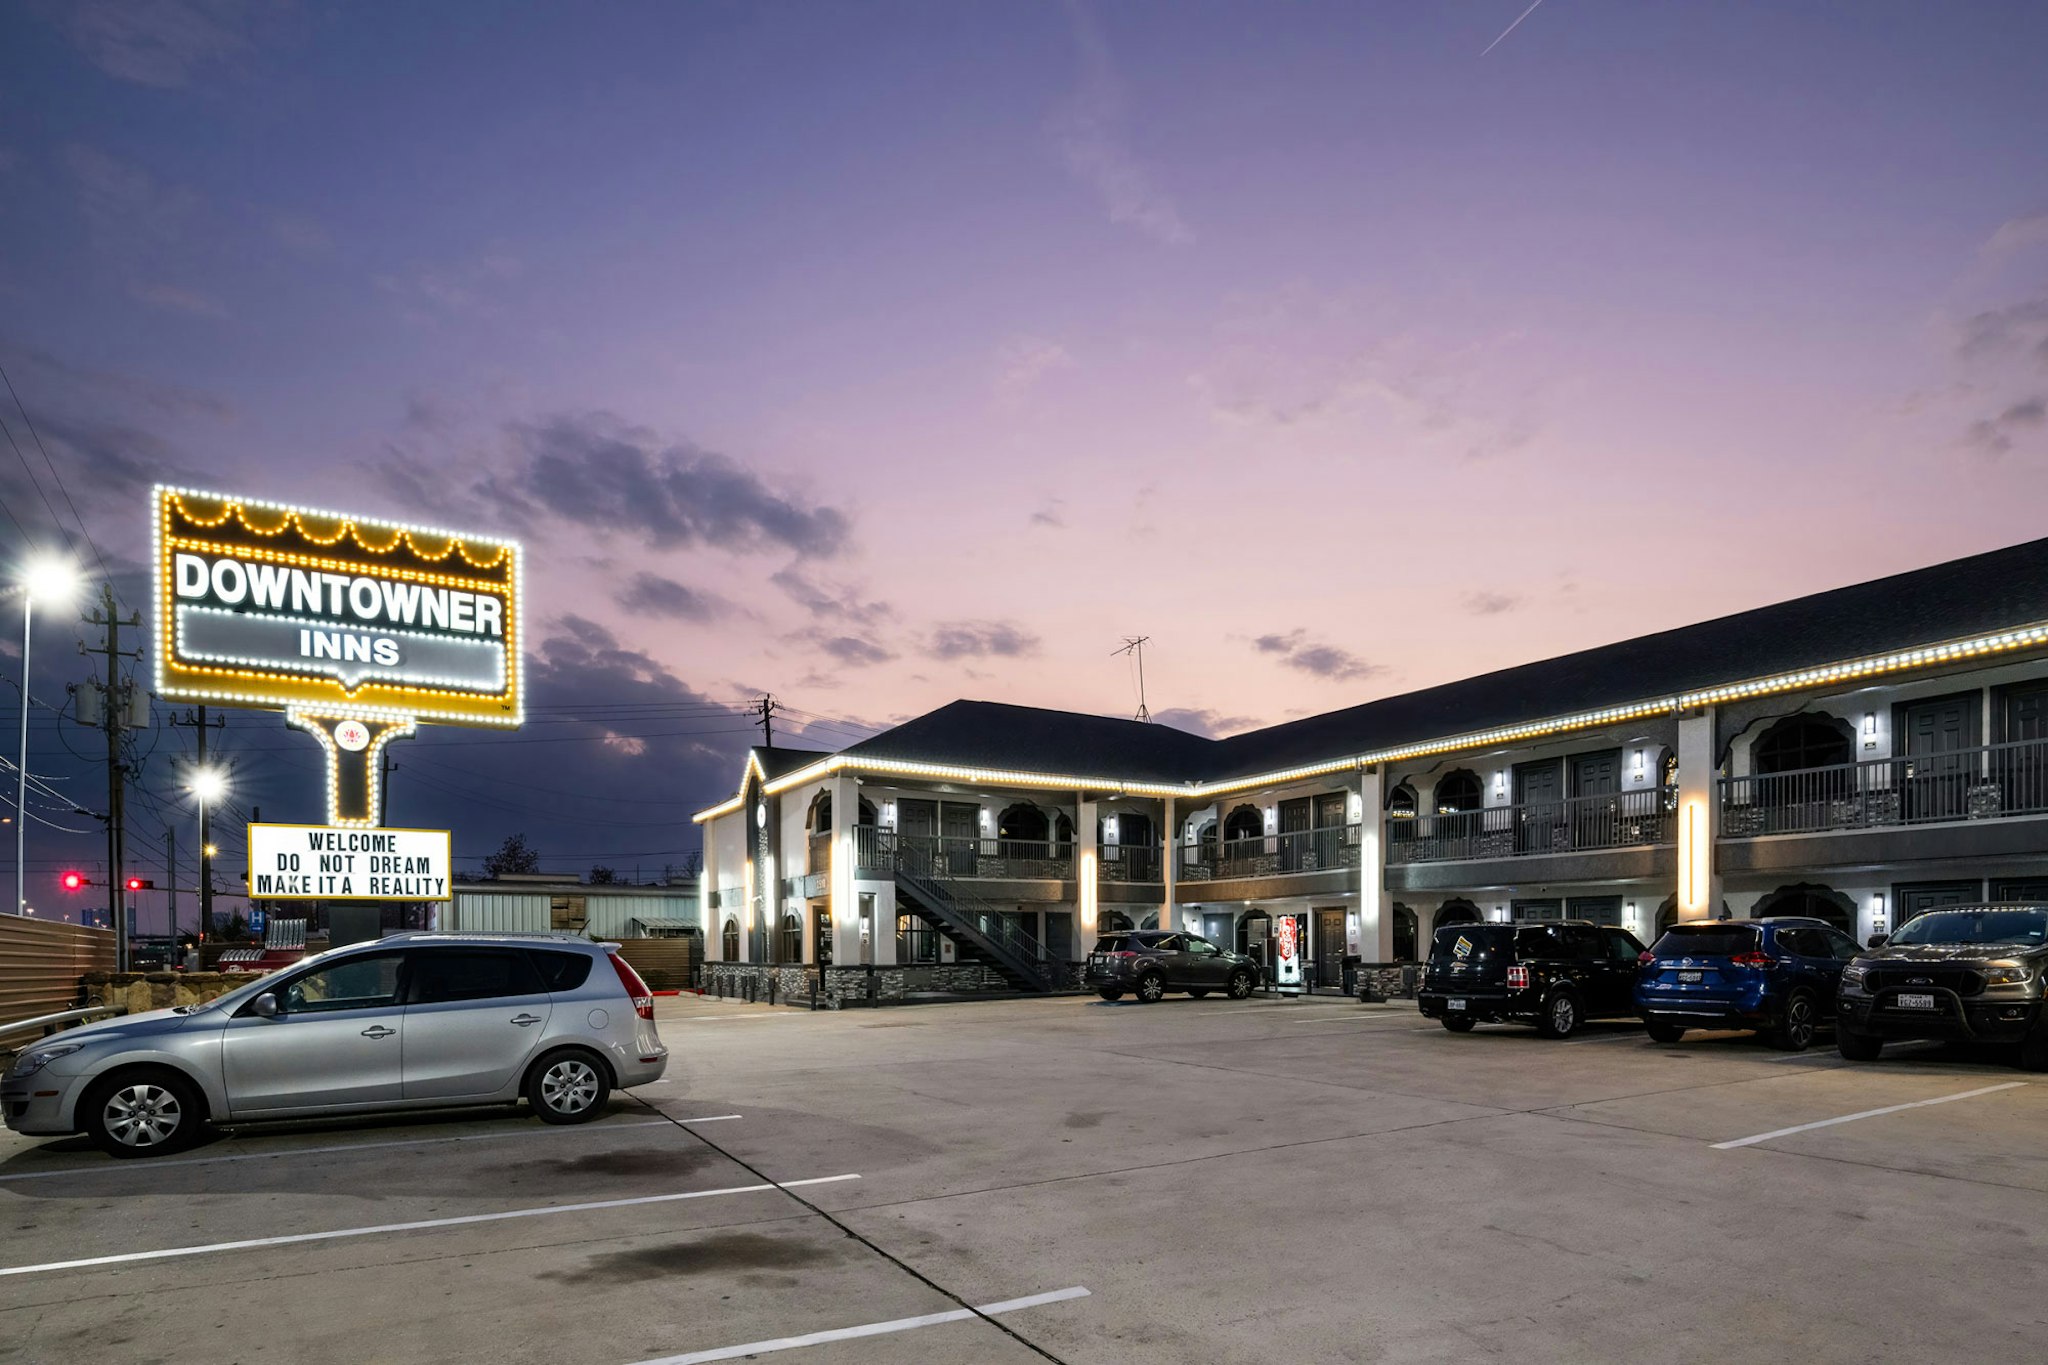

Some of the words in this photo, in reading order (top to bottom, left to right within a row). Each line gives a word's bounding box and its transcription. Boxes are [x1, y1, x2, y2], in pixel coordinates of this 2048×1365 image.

[175, 553, 502, 636] DOWNTOWNER
[300, 630, 400, 666] INNS
[308, 832, 397, 852] WELCOME
[277, 853, 300, 872] DO
[319, 855, 355, 873] NOT
[370, 856, 430, 875] DREAM
[257, 875, 311, 894] MAKE
[370, 878, 445, 895] REALITY
[251, 912, 262, 923] H
